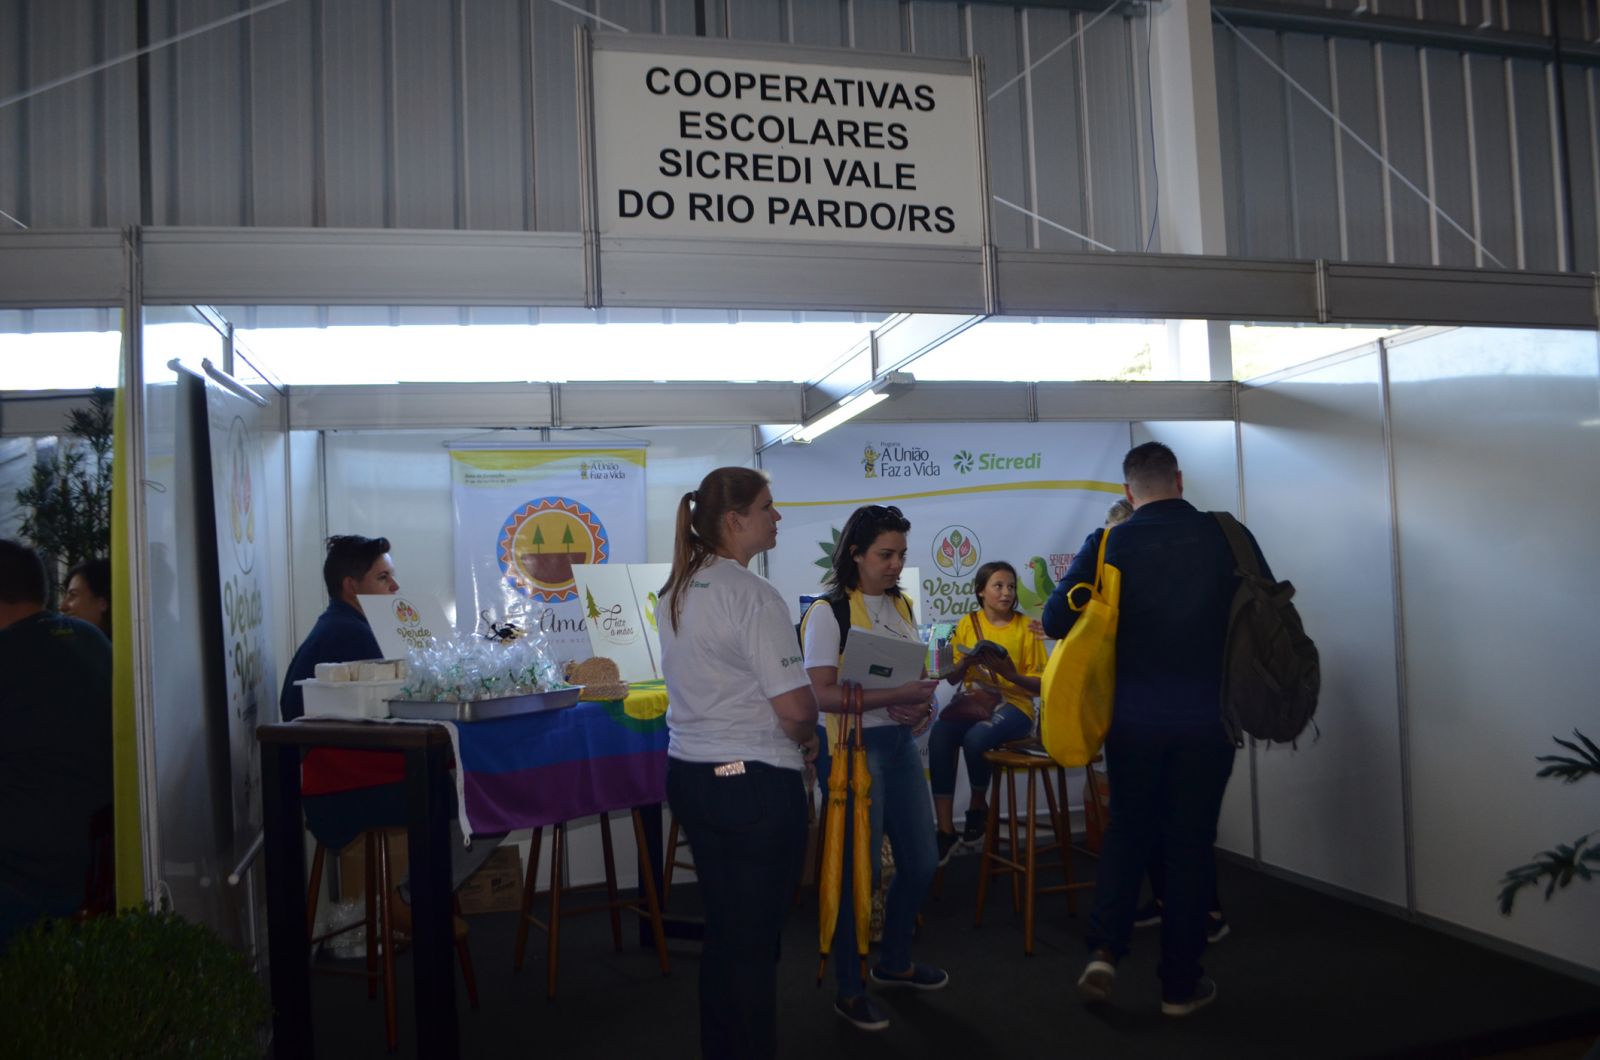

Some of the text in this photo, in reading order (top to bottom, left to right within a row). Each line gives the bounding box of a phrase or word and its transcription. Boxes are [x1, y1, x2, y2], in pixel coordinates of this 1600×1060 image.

[645, 66, 937, 112] COOPERATIVAS
[679, 110, 909, 151] ESCOLARES
[659, 148, 917, 190] SICREDI VALE
[618, 189, 956, 233] DO RIO PARDO/RS
[881, 447, 929, 462] A União
[978, 452, 1042, 471] Sicredi
[881, 461, 941, 477] Faz a Vida
[922, 577, 977, 596] Verd
[933, 596, 981, 616] Vale
[396, 626, 432, 638] Verde
